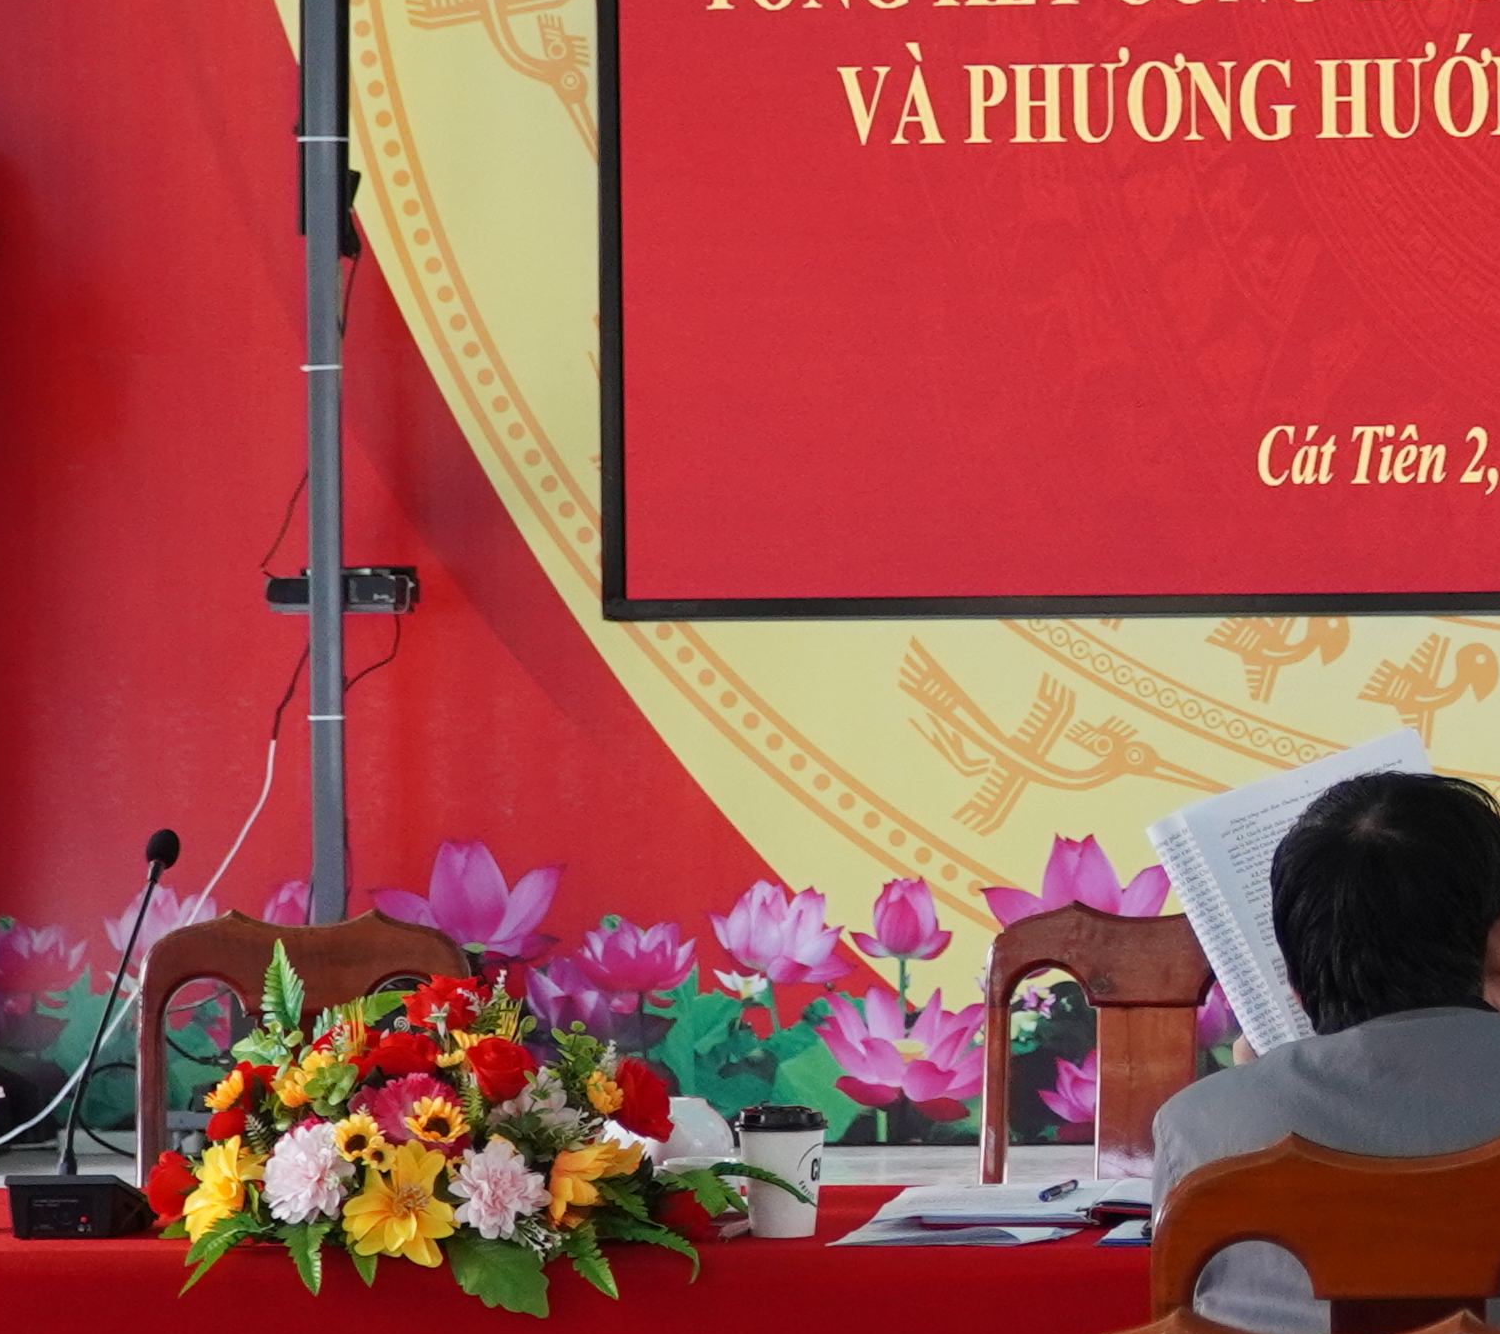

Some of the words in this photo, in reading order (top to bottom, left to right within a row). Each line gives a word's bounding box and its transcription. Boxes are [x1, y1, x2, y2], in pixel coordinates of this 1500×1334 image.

[836, 41, 946, 146] VÀ
[963, 46, 1297, 144] PHƯƠNG
[1257, 424, 1337, 487] Cát
[1350, 423, 1447, 485] Tiên
[1459, 426, 1499, 495] 2,
